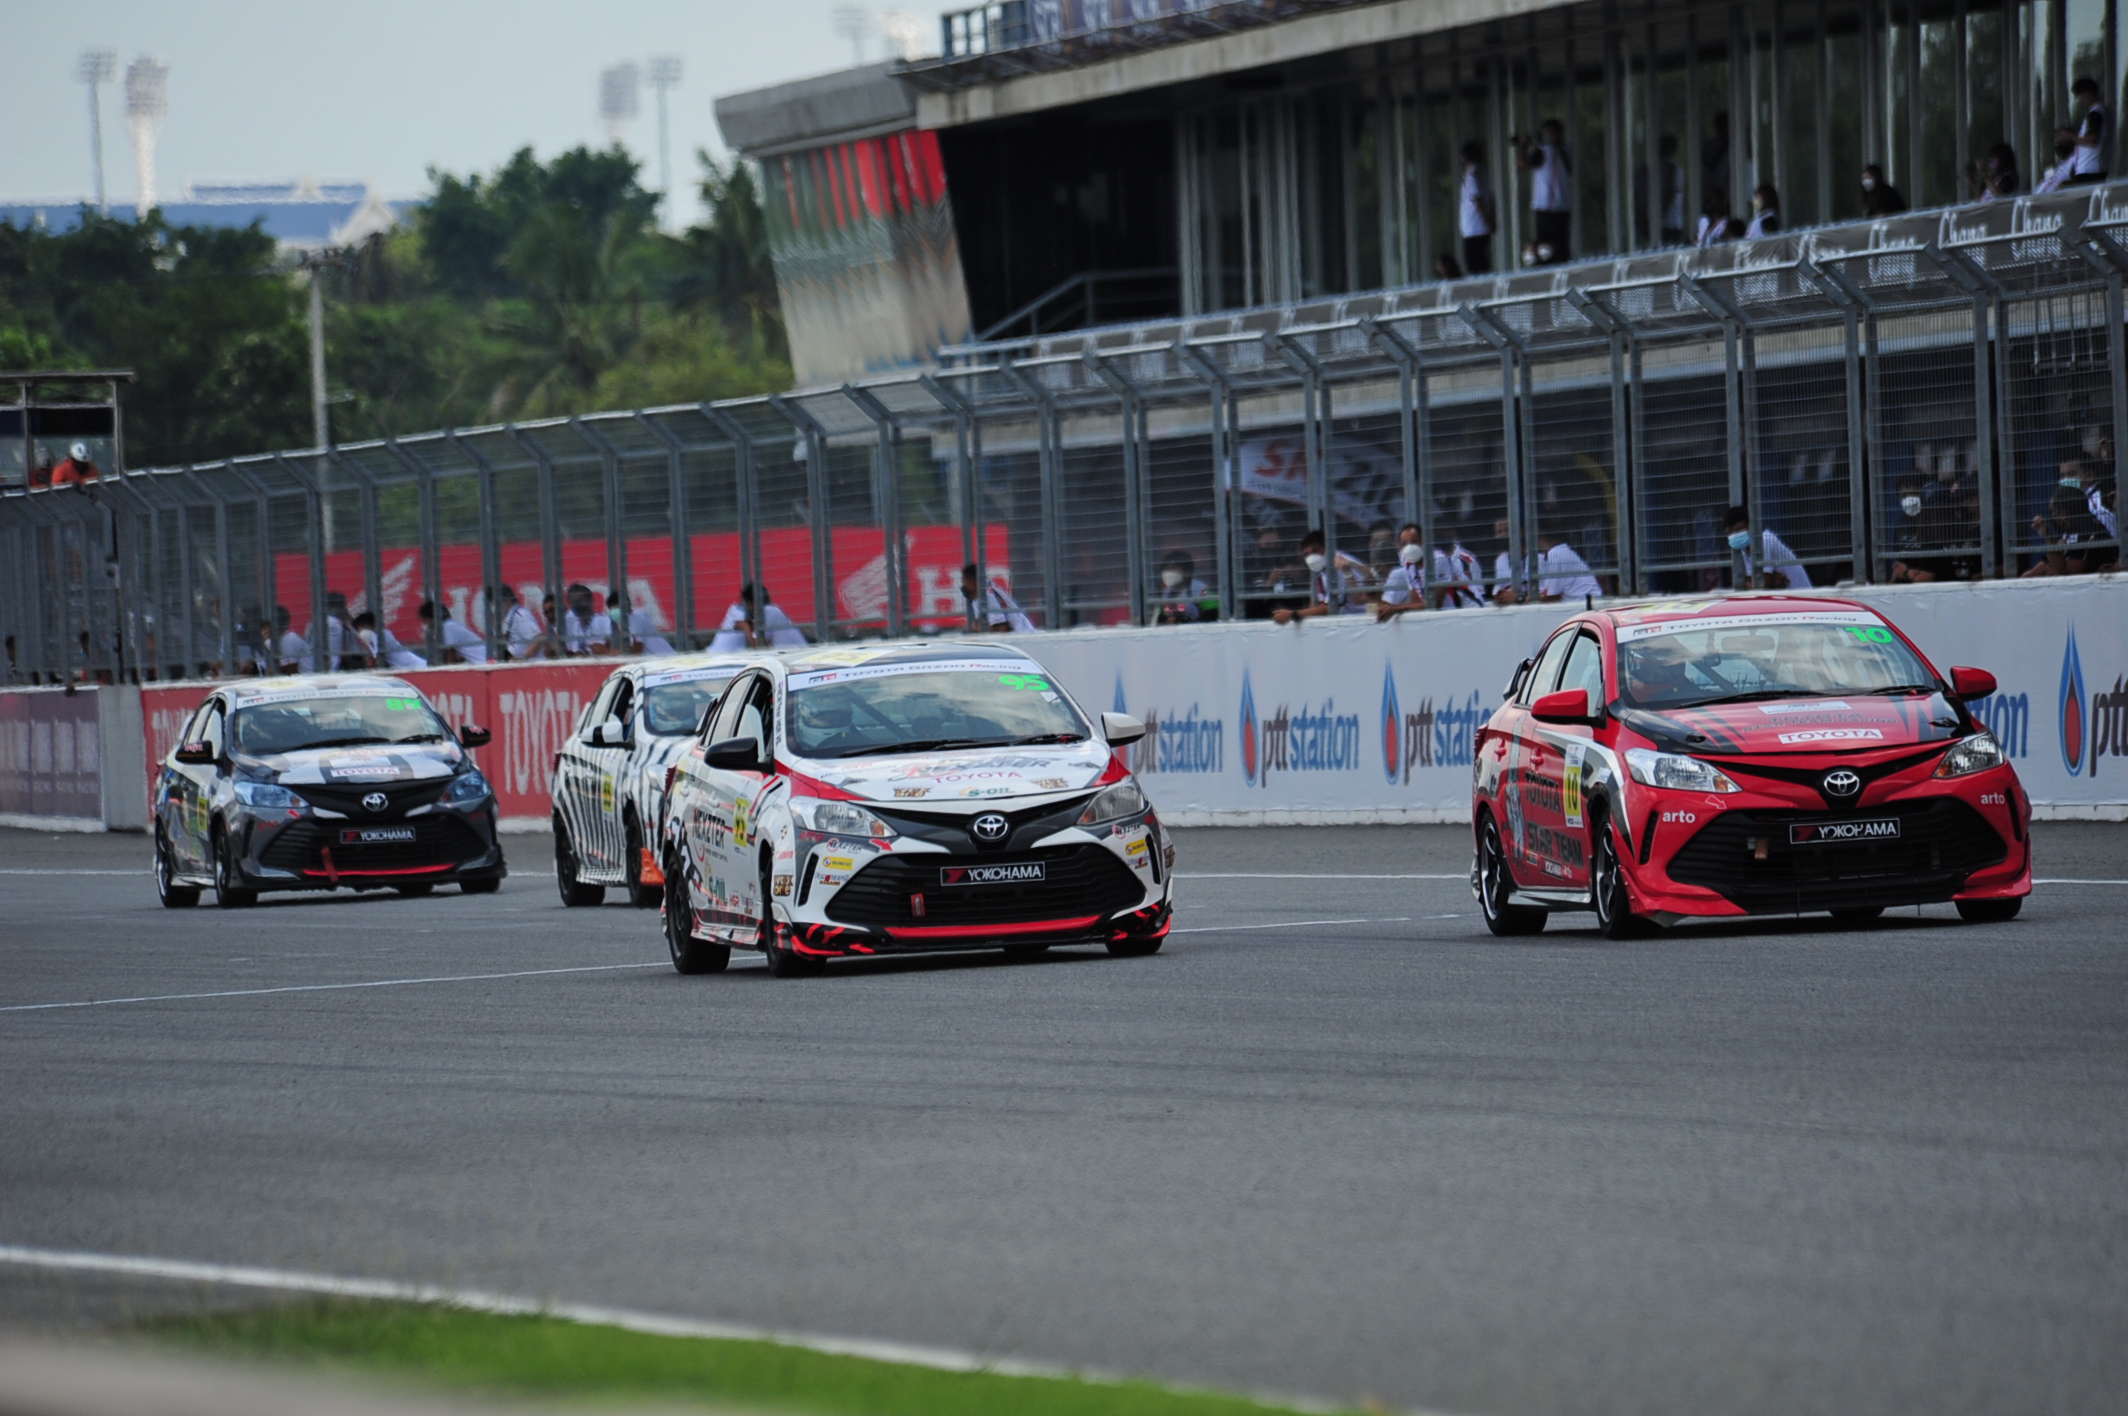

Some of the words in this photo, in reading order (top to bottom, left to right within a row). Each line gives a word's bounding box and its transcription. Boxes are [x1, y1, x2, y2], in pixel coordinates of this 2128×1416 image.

[1844, 627, 1893, 644] 10
[842, 666, 905, 678] TOYOTA
[999, 674, 1049, 691] 95
[1782, 730, 1880, 742] TOYOTA
[333, 766, 398, 776] TOYOTA
[931, 771, 1023, 784] TOYOTA
[1567, 773, 1579, 811] 10
[1981, 792, 2005, 804] arto
[1662, 810, 1696, 823] arto
[360, 829, 414, 842] YOKOHAMA
[1818, 822, 1897, 838] YOKOHAMA
[967, 865, 1042, 881] YOKOHAMA
